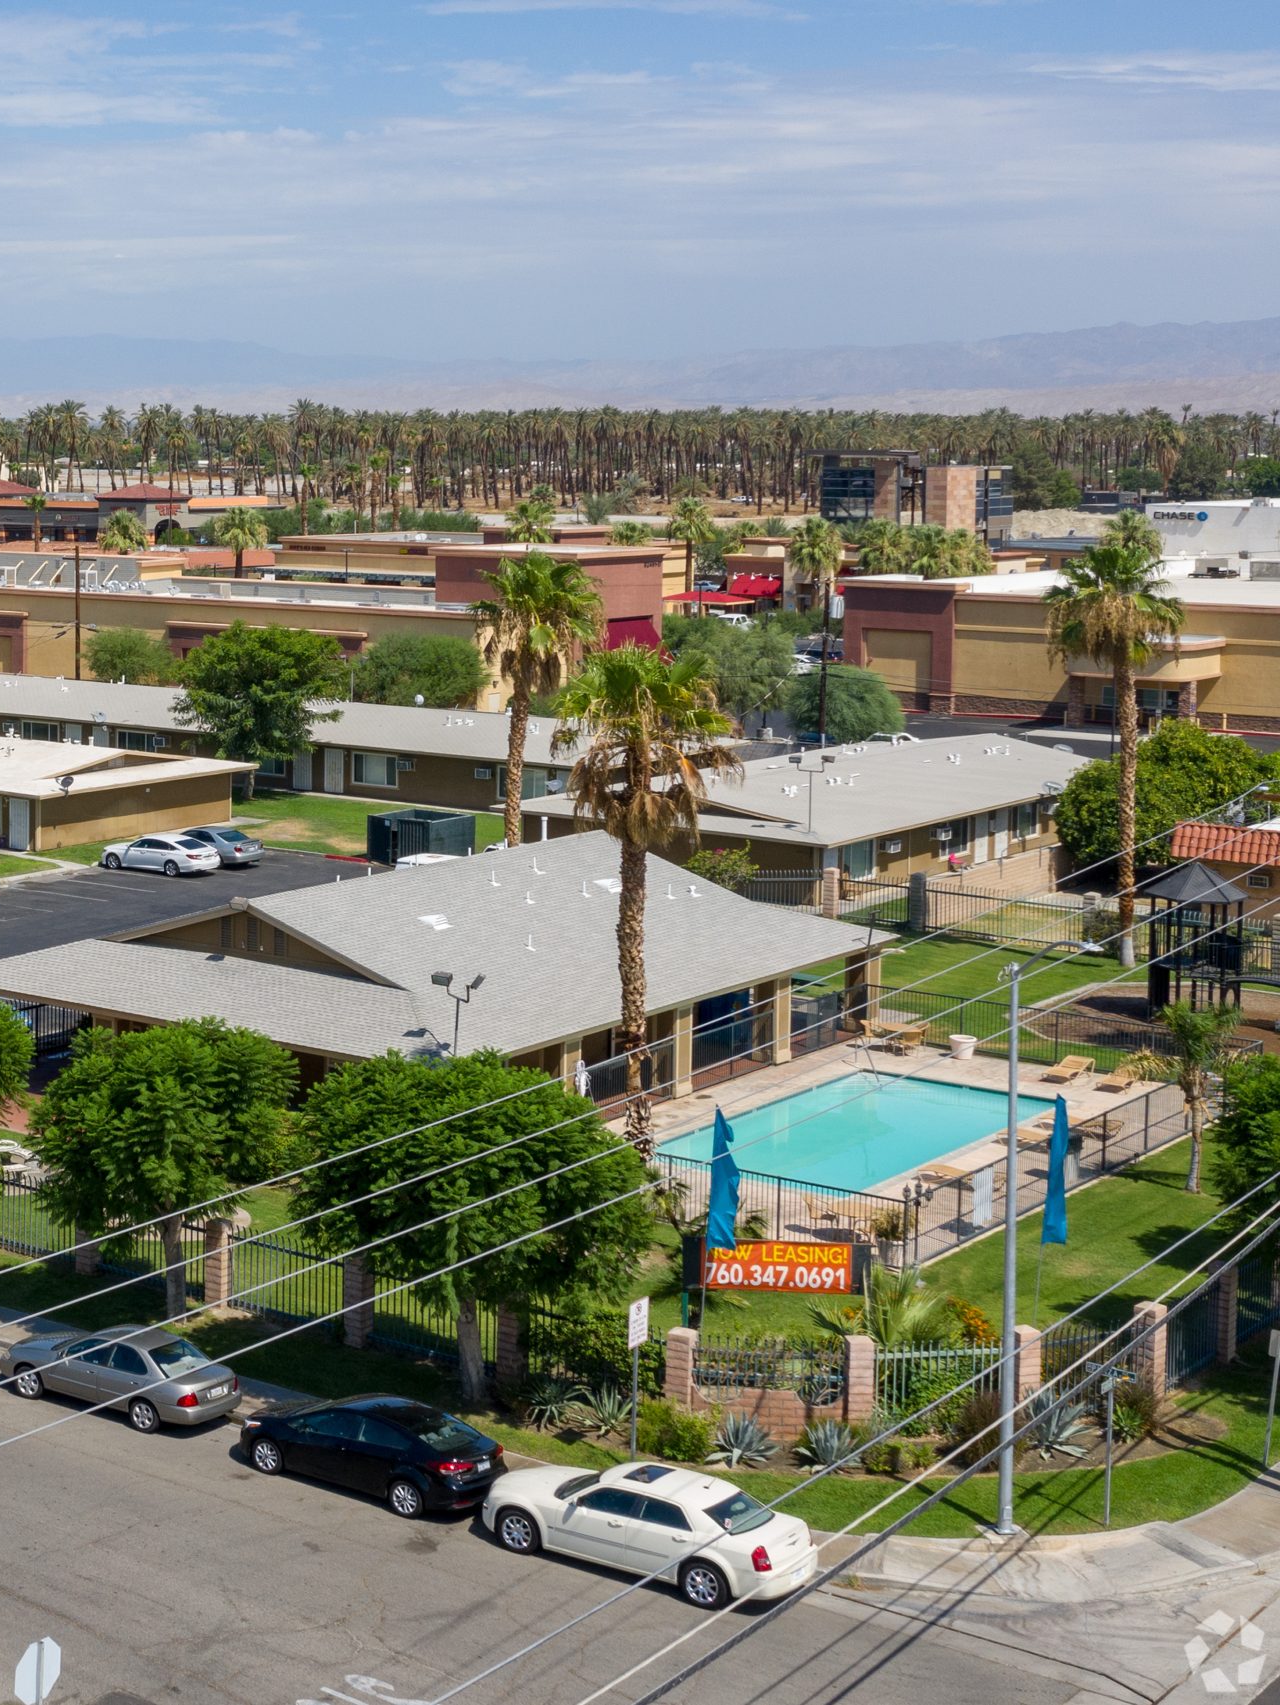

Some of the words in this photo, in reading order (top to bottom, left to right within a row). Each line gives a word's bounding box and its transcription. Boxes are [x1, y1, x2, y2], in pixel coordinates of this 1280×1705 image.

[1153, 511, 1195, 520] CHASE
[762, 1244, 848, 1264] LEASING!
[706, 1262, 846, 1290] 760.347.0691
